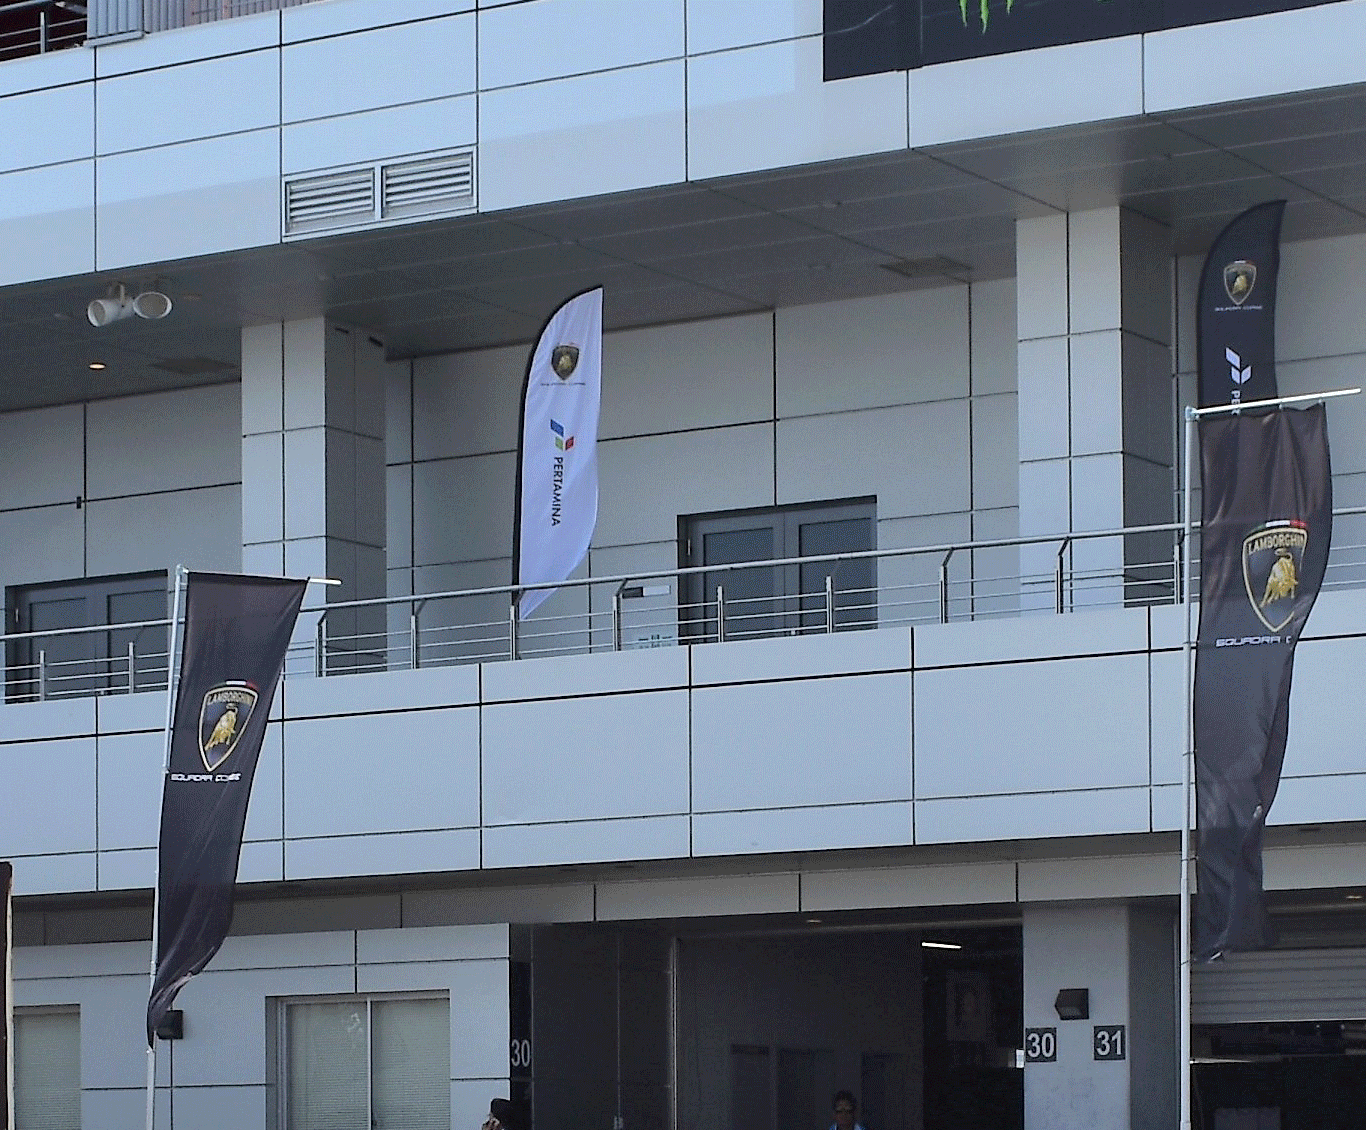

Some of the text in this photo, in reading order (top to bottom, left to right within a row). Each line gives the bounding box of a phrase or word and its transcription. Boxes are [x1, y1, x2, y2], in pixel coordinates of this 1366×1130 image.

[551, 456, 564, 527] PERTAMINA
[1248, 532, 1304, 555] LAMBORGHIN
[511, 1039, 531, 1067] 30
[1027, 1032, 1055, 1058] 30
[1096, 1030, 1122, 1056] 31
